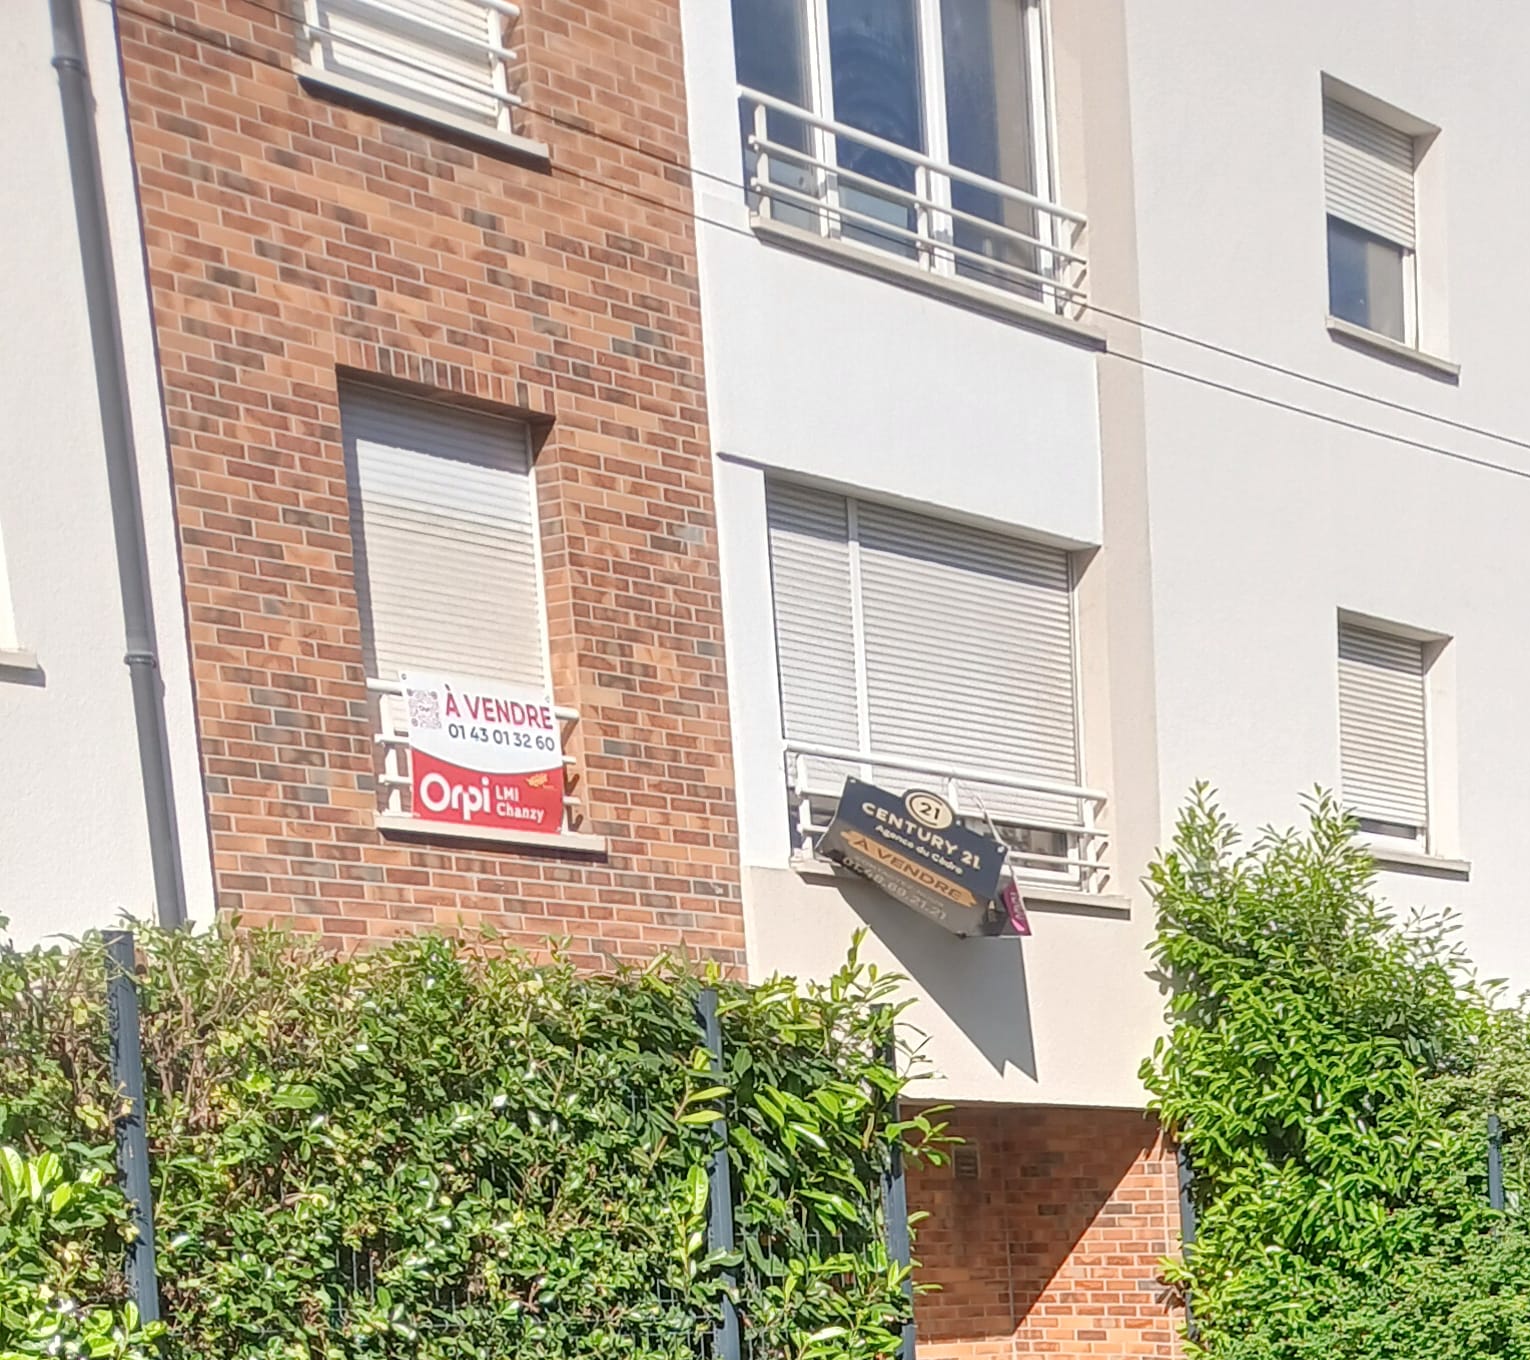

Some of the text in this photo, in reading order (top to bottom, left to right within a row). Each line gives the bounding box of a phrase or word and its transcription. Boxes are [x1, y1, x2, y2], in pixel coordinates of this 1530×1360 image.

[445, 683, 553, 730] À VENDRE
[448, 723, 555, 752] 01 43 01 32 60
[420, 772, 491, 821] Orpi
[495, 785, 520, 802] LMI
[496, 802, 545, 824] Chanzy
[920, 801, 941, 820] 21
[862, 802, 981, 870] CENTURY 21
[875, 824, 915, 849] Agence
[916, 846, 930, 857] du
[854, 838, 870, 851] A
[877, 847, 963, 901] VENDRE
